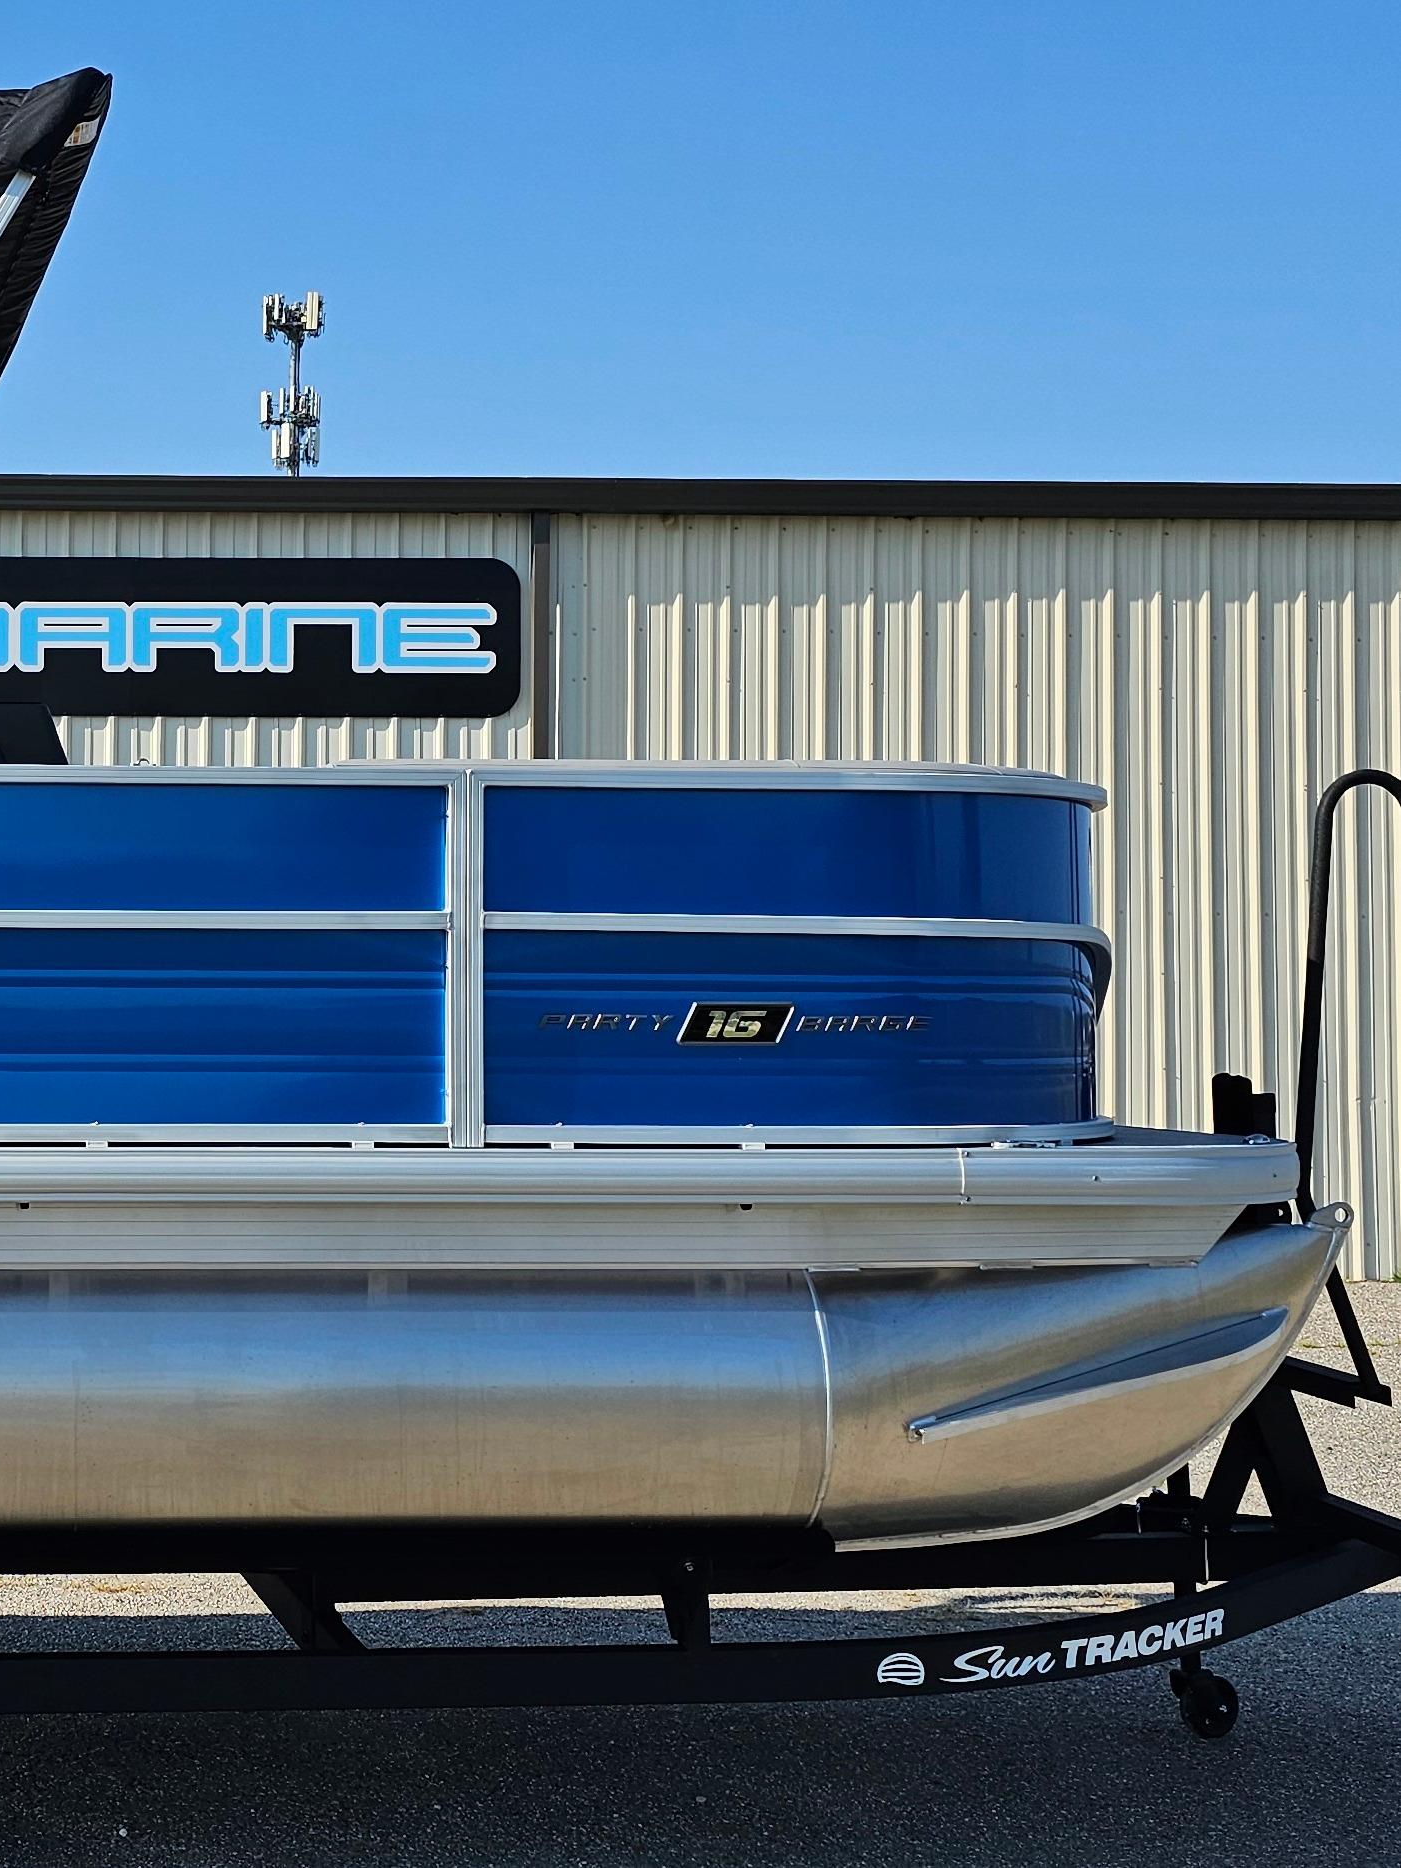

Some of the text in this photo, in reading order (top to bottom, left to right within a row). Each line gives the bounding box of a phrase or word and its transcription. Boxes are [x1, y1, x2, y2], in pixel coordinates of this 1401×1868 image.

[539, 1010, 934, 1038] PARTY 16 BARGE
[939, 1608, 1225, 1683] Sun TRACKER
